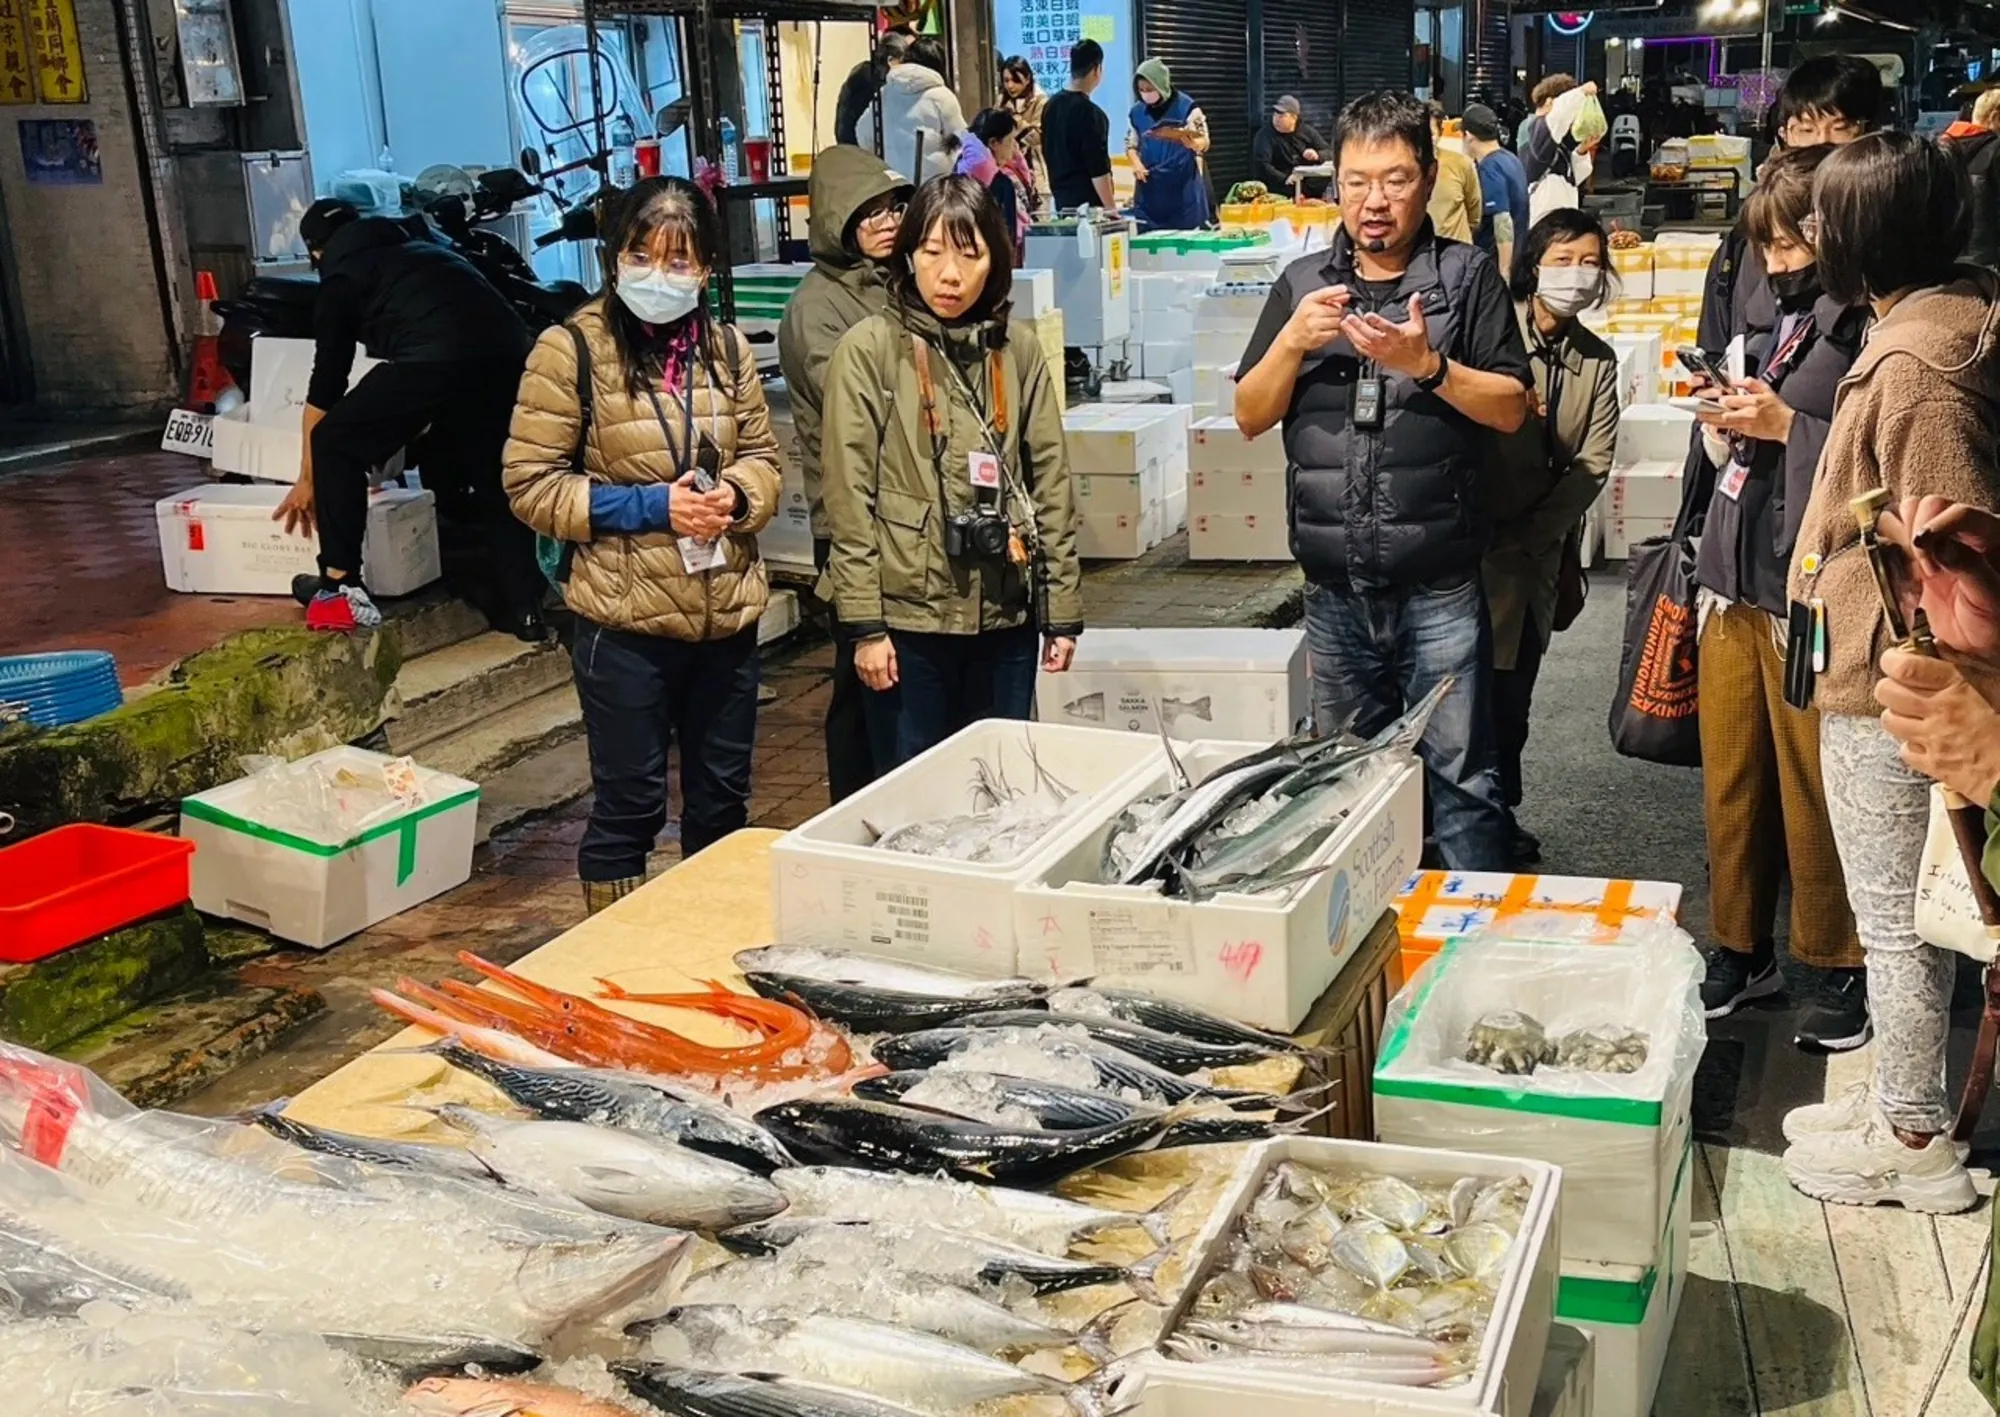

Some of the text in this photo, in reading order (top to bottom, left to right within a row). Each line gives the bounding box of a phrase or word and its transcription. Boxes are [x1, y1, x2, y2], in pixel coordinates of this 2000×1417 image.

[1021, 14, 1079, 28] 南美白蝦
[1022, 29, 1080, 44] 進口草蝦
